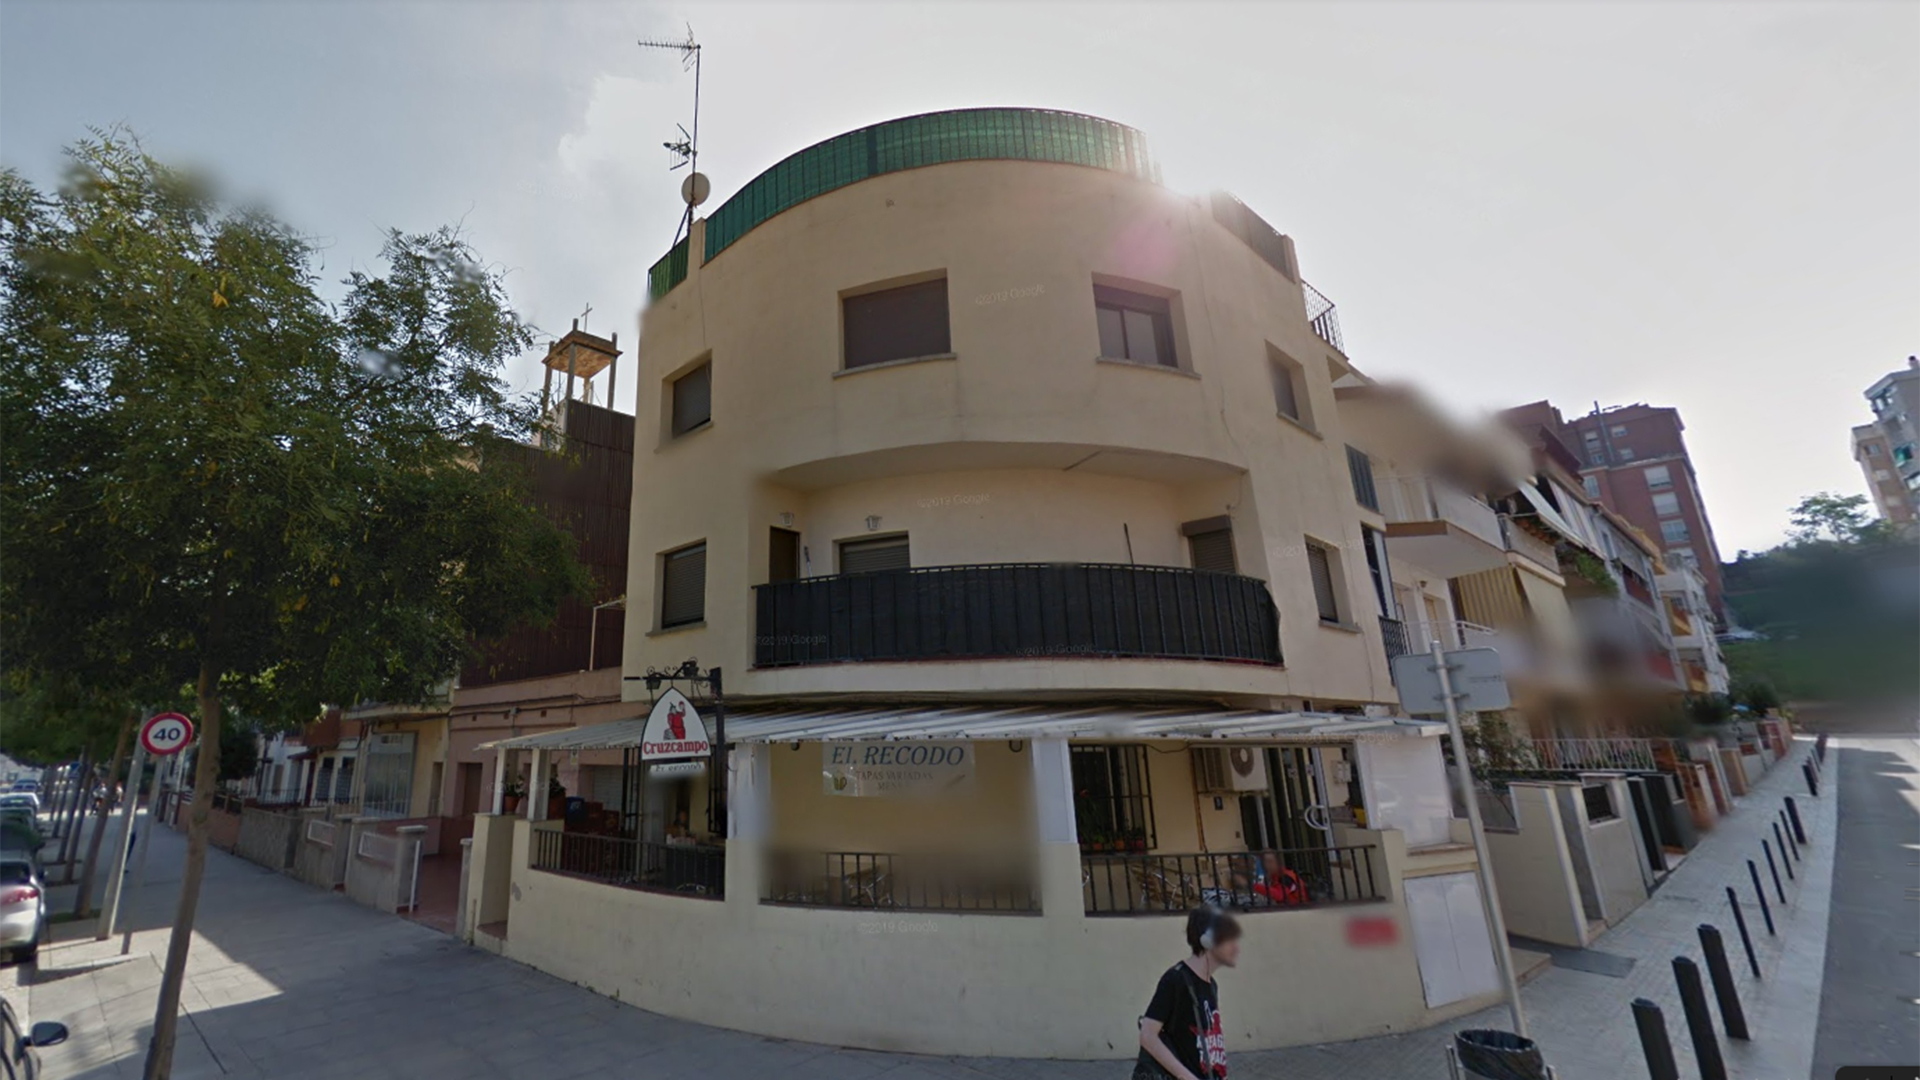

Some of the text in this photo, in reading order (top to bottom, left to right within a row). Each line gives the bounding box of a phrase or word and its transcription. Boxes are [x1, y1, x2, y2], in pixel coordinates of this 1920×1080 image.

[152, 727, 181, 741] 40
[643, 740, 709, 755] Cruzcampo
[862, 745, 965, 766] RECODO
[856, 770, 934, 781] TAPAS VARIADAS
